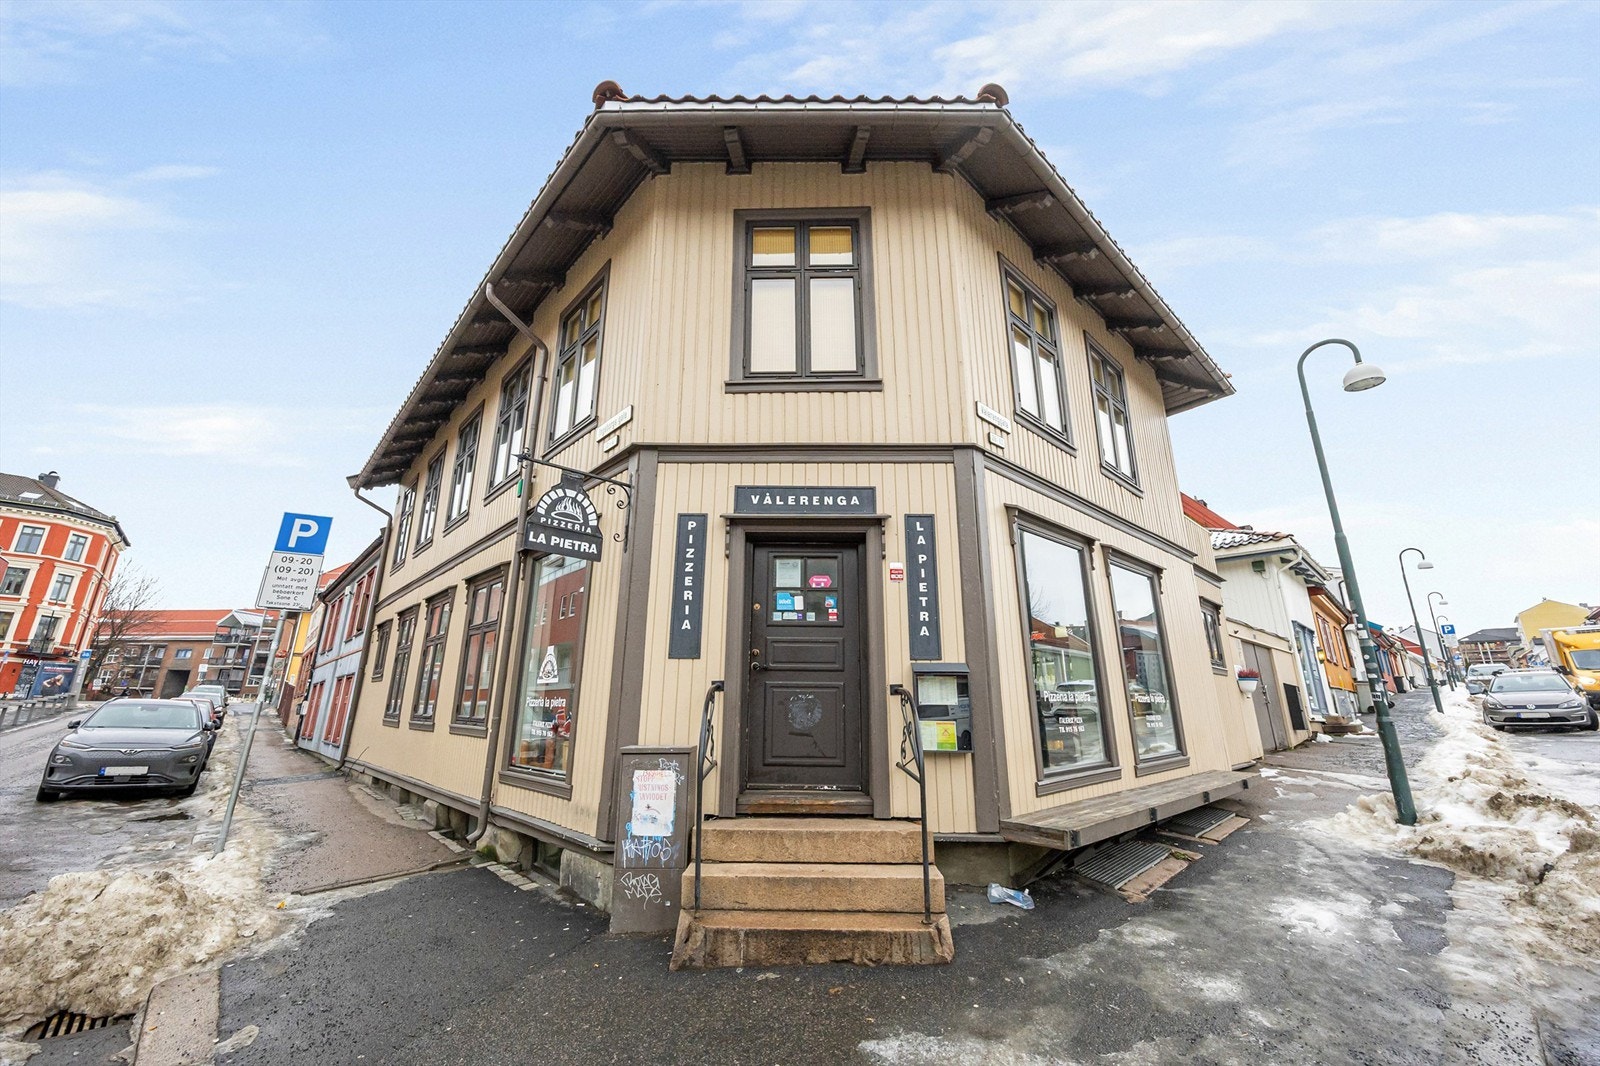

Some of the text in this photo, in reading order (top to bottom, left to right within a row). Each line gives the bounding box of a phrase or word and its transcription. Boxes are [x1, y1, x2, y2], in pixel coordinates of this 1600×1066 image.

[750, 492, 860, 506] VÅLERENGA
[288, 518, 319, 548] P
[540, 517, 592, 534] PIZZERIA
[528, 531, 598, 554] LA PIETRA
[681, 520, 696, 630] PIZZERIA
[916, 521, 930, 636] LA PIETRA
[1444, 625, 1452, 633] P
[1043, 690, 1067, 702] Pizzeria
[1068, 691, 1074, 702] la
